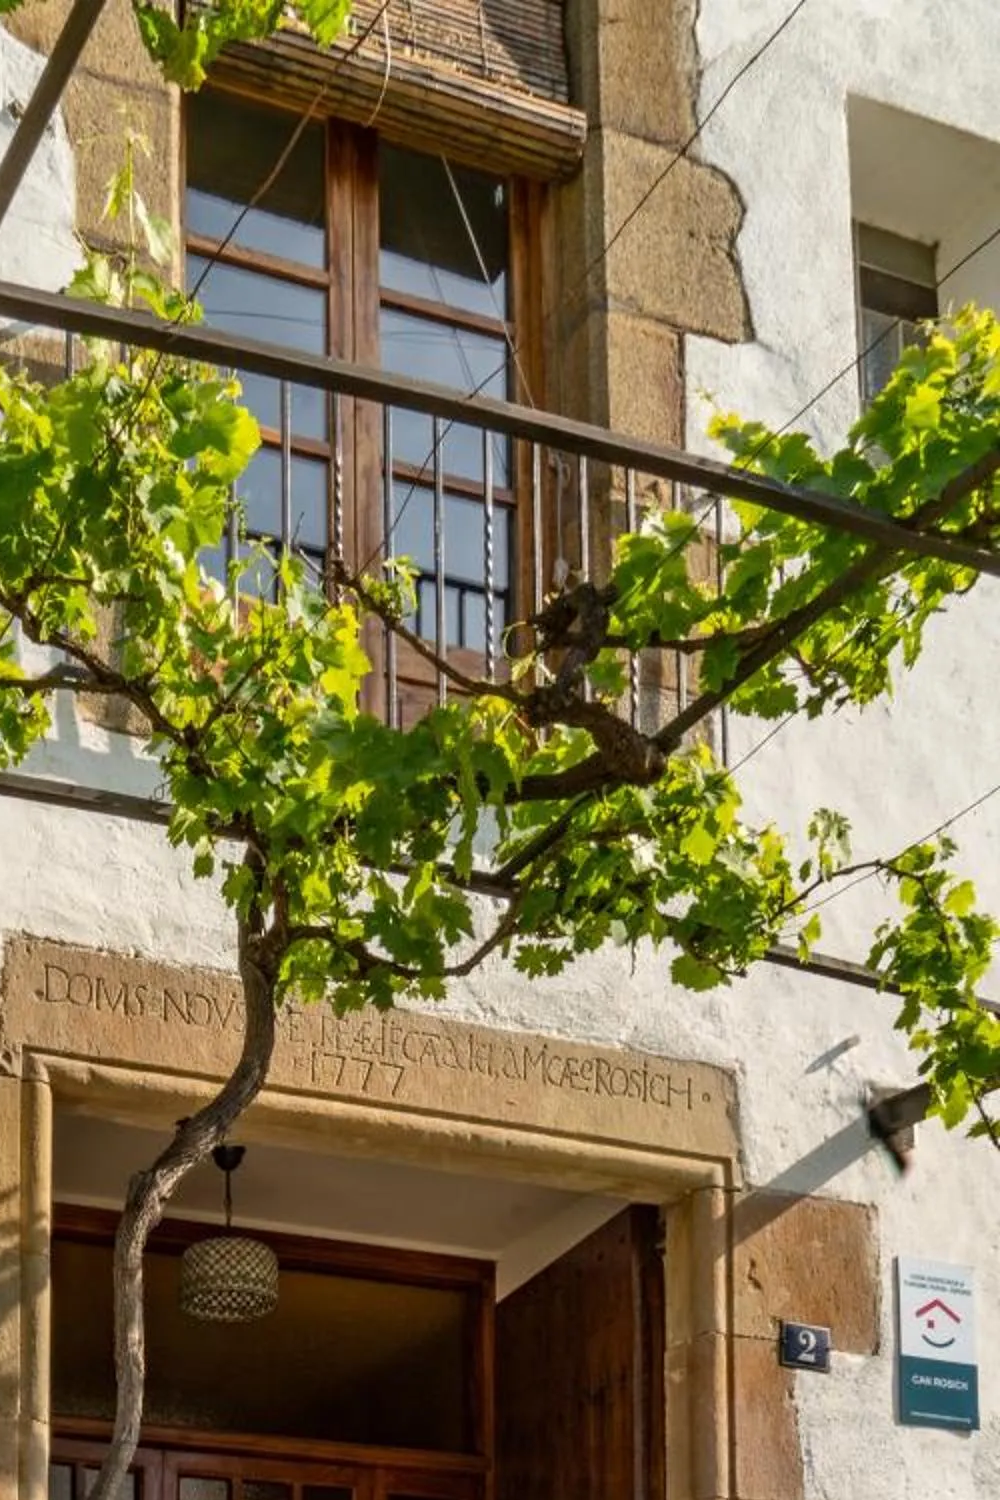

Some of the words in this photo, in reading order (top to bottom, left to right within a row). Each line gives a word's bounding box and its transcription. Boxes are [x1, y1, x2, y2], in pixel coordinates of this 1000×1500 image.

[309, 1049, 406, 1098] 1777
[796, 1329, 817, 1363] 2
[910, 1374, 932, 1387] CAN
